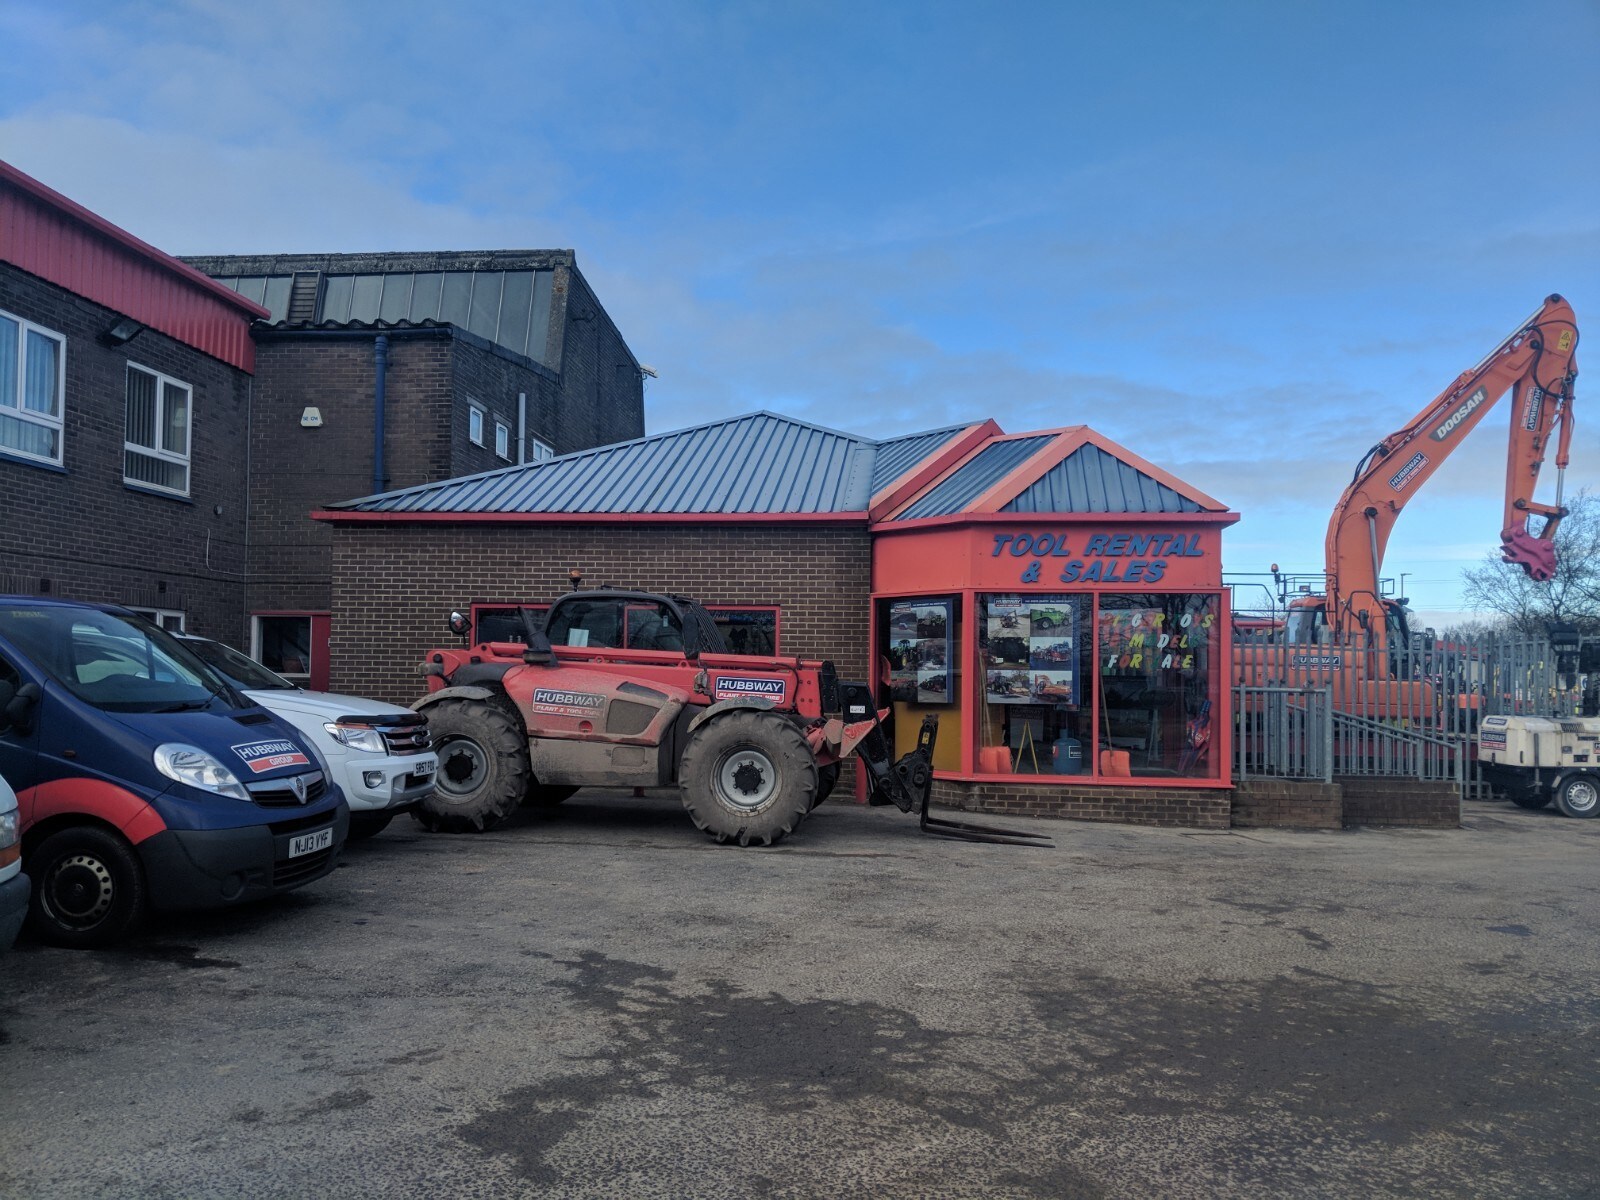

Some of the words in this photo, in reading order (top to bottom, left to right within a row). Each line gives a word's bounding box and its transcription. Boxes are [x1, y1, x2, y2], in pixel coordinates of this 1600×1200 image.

[1436, 391, 1484, 439] DOOSAN
[1391, 454, 1422, 487] HUBBWAY
[991, 533, 1070, 557] TOOL
[1083, 533, 1204, 557] RENTAL
[1020, 560, 1042, 583] &
[1059, 560, 1168, 583] SALES
[1107, 653, 1144, 669] FOR
[718, 680, 782, 692] HUBBWAY
[536, 692, 604, 707] HUBBWAY
[238, 743, 294, 758] HUBBWAY
[269, 756, 294, 766] GROUP
